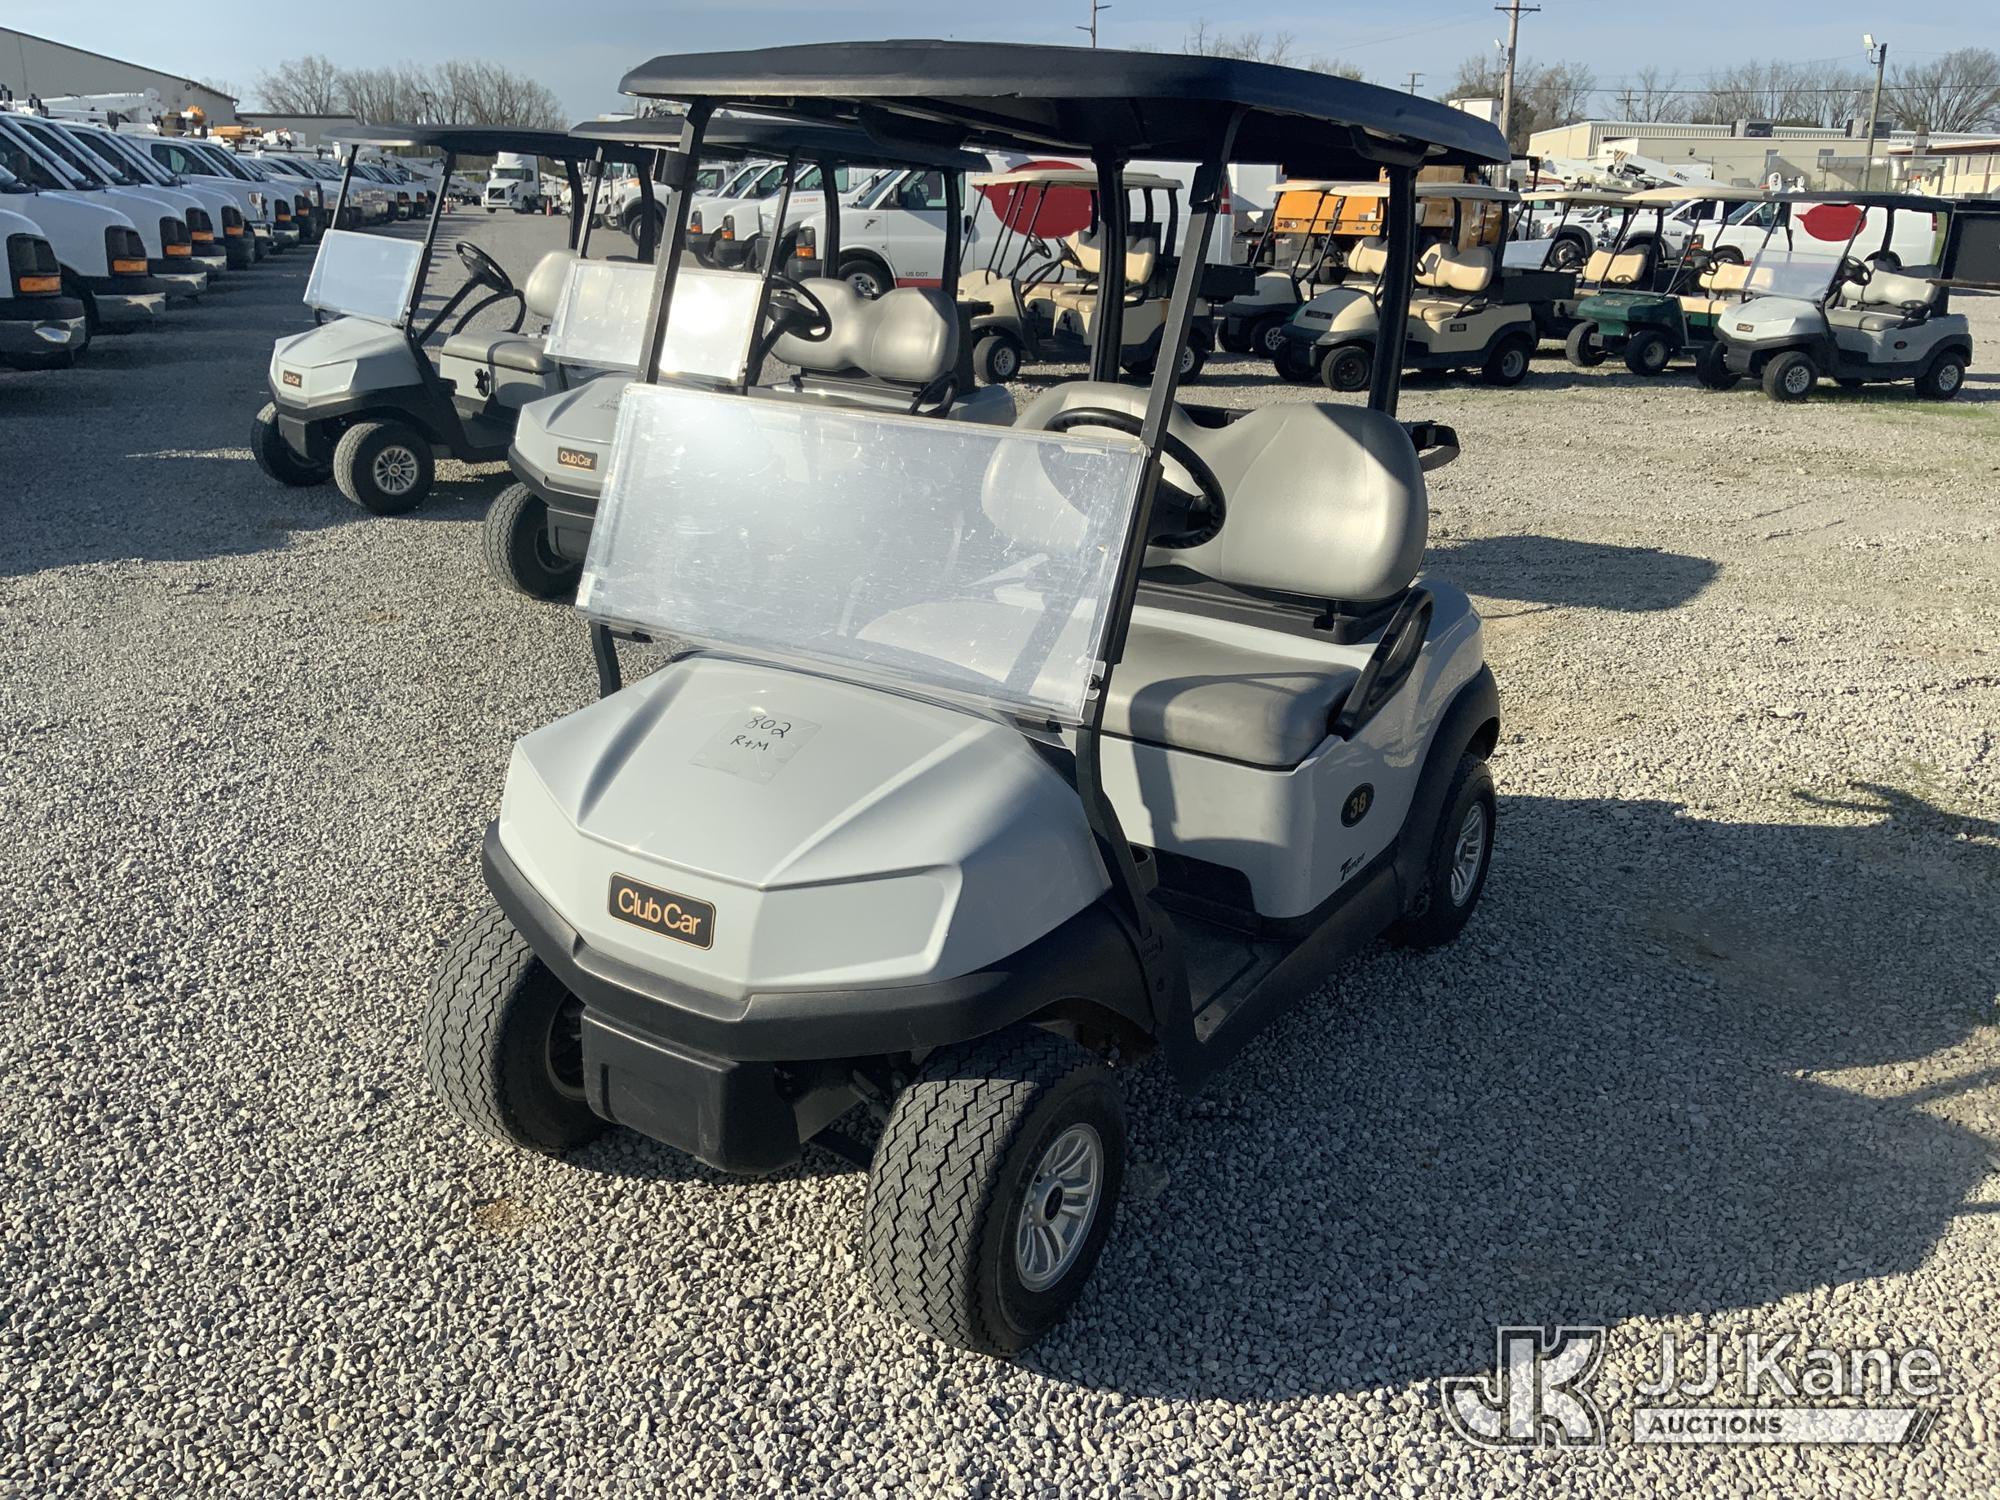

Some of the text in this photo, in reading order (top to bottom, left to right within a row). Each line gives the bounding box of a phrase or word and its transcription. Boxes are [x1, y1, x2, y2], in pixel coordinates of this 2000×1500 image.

[561, 450, 592, 466] Club Car
[745, 715, 792, 738] 802
[1350, 791, 1367, 819] 38
[618, 887, 702, 936] Club Car
